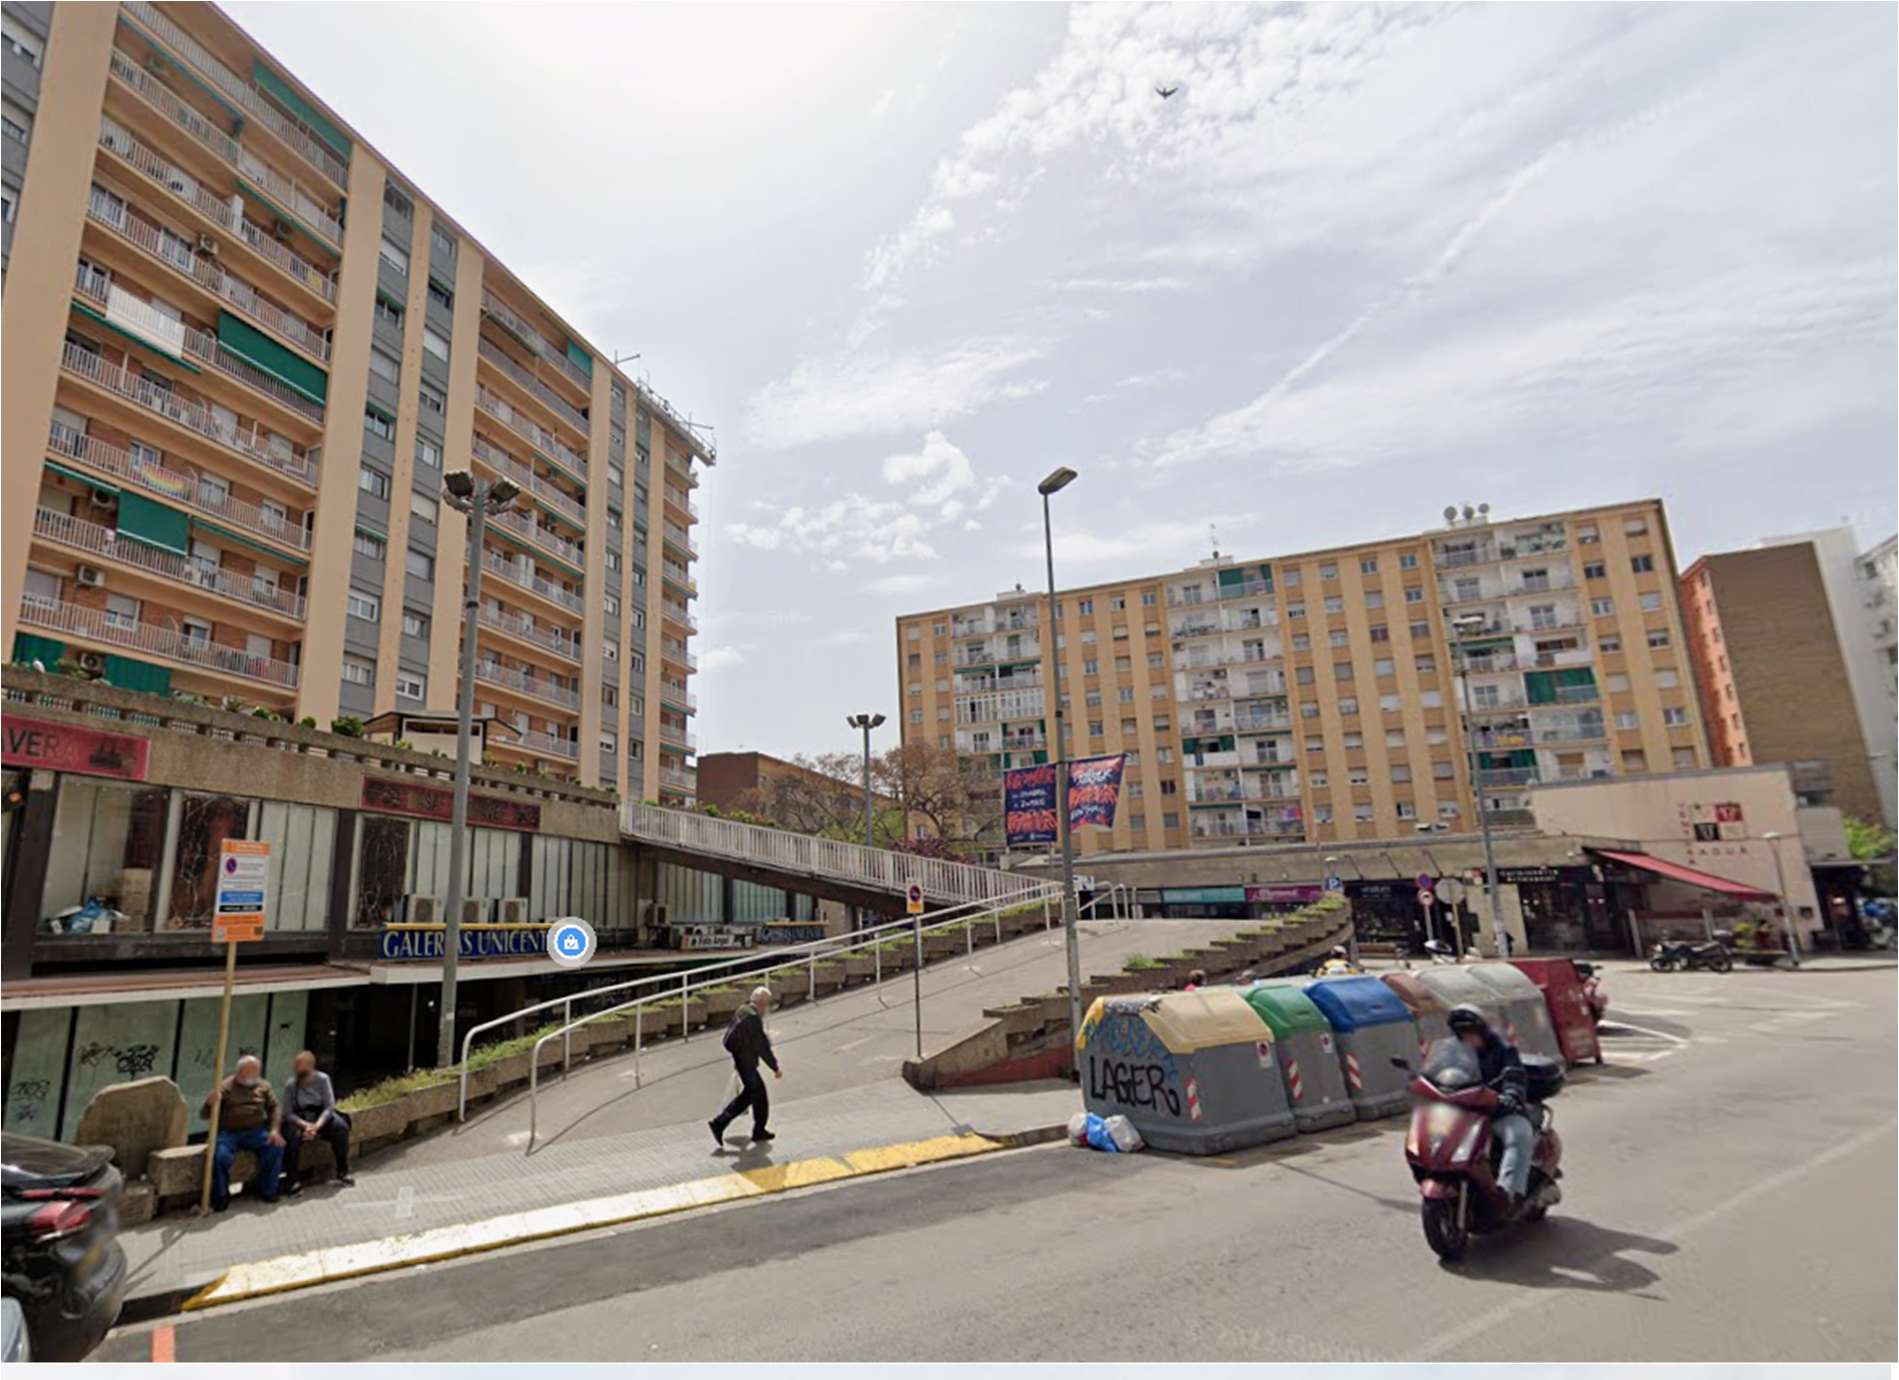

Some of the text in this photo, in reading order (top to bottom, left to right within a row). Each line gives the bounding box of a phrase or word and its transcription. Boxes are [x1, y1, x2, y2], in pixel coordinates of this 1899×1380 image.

[383, 929, 548, 957] GALERAS UNICENT
[1089, 1055, 1181, 1117] LAGER
